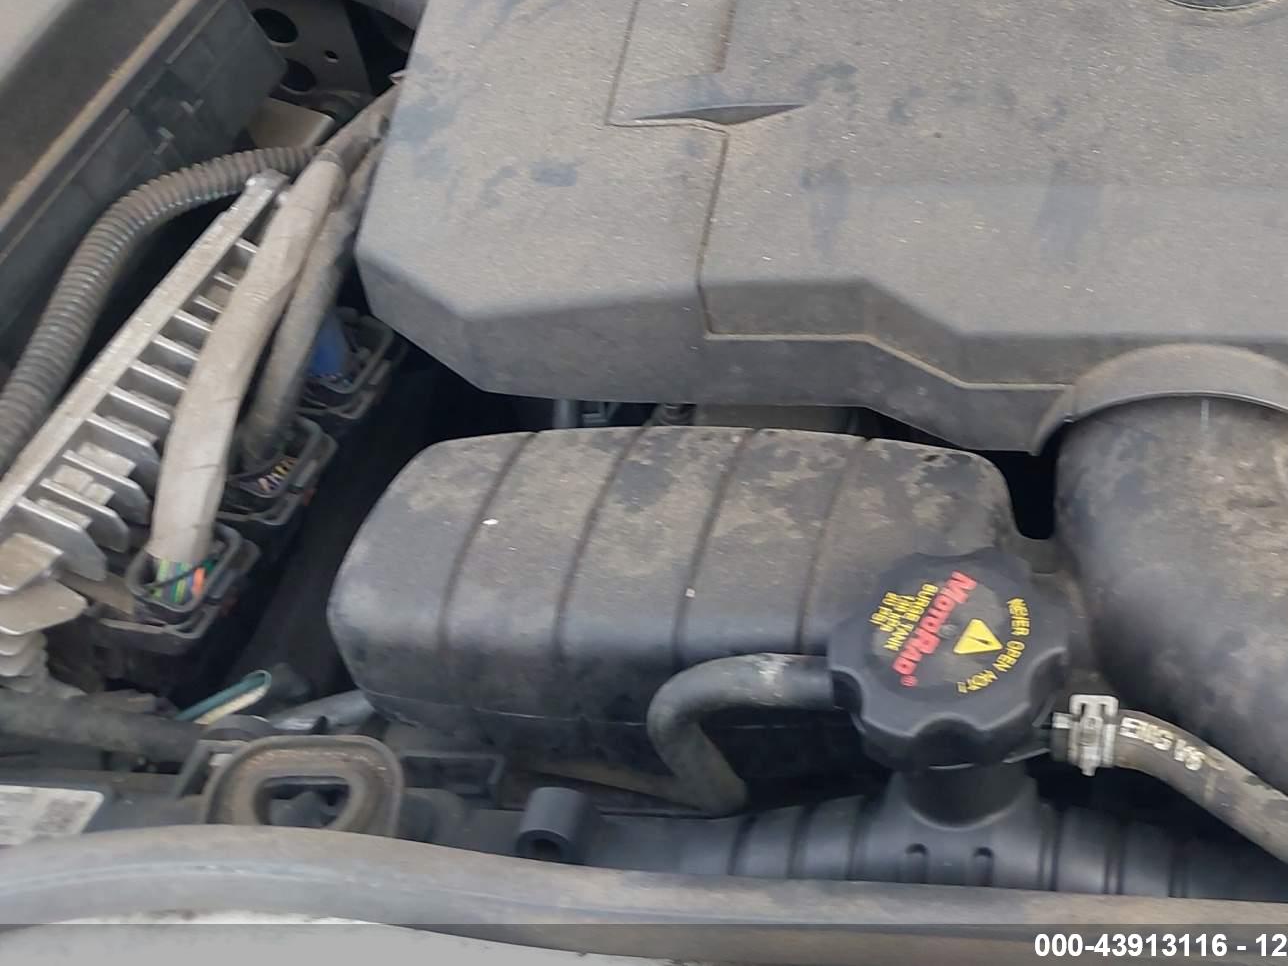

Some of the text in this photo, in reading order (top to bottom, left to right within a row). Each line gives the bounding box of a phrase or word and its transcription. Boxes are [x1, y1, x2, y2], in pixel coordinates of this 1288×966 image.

[1007, 598, 1030, 636] NEVER
[883, 623, 914, 651] TANK
[992, 640, 1025, 672] OPEN
